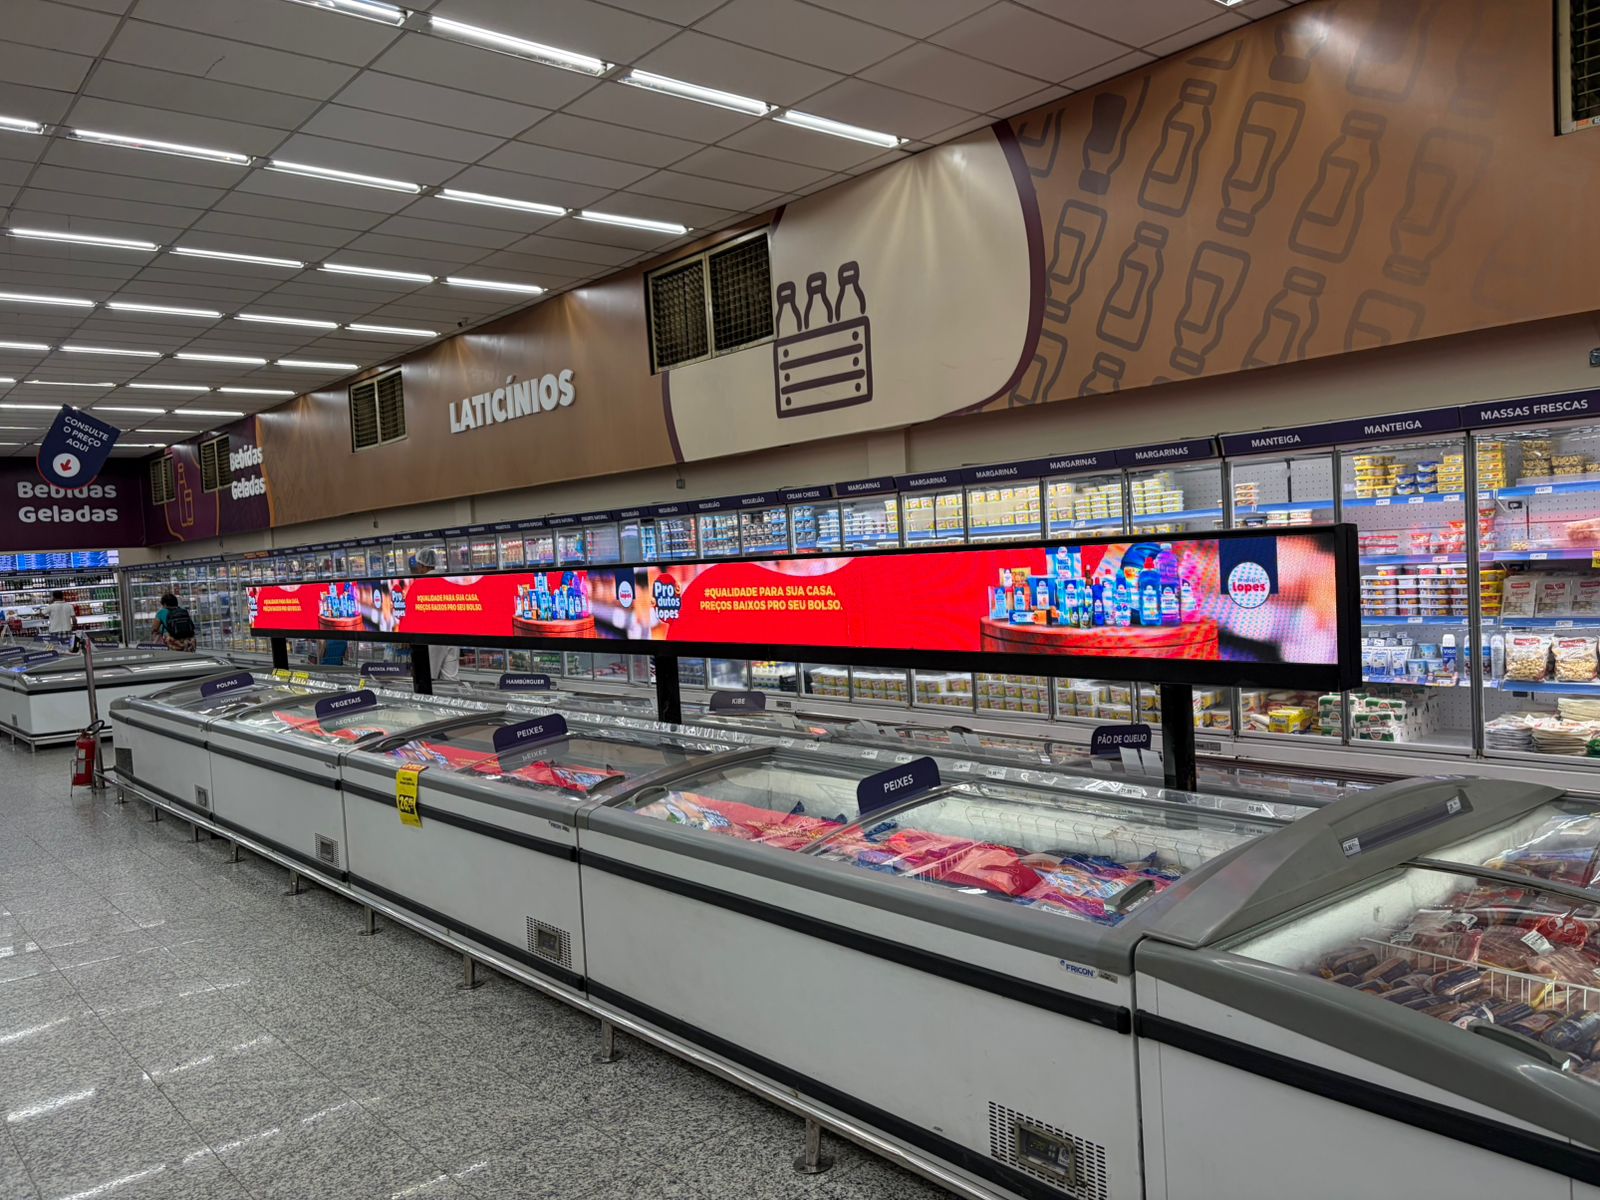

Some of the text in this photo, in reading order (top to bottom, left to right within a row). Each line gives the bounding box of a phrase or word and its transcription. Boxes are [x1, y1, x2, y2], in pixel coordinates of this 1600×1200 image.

[450, 368, 576, 434] LATICÍNIOS
[1481, 400, 1588, 420] MASSAS FRESCAS
[64, 416, 110, 441] CONSULTE
[1364, 420, 1422, 434] MANTEIGA
[66, 438, 89, 452] AQUI
[72, 430, 101, 448] PREÇO
[1251, 434, 1301, 448] MANTEIGA
[230, 445, 263, 472] Bebidas
[1135, 446, 1189, 460] MARGARINAS
[1050, 457, 1097, 470] MARGARINAS
[975, 466, 1018, 478] MARGARINAS
[232, 474, 266, 500] Geladas
[848, 481, 880, 491] MARGARINAS
[909, 476, 947, 487] MARGARINAS
[17, 481, 117, 498] Bebidas
[18, 505, 118, 524] Geladas
[654, 582, 674, 597] Pro
[704, 588, 758, 599] #QUALIDADE
[759, 586, 784, 597] PARA
[786, 586, 804, 596] SUA
[1232, 582, 1266, 594] lopes
[658, 596, 680, 607] dutos
[700, 600, 843, 613] PREÇOS BAIXOS PRO SEU BOLSO.
[656, 606, 679, 622] lopes
[216, 679, 238, 690] POLPAS
[506, 677, 544, 686] HAMBÚRGUER
[330, 696, 362, 710] VEGETAIS
[732, 698, 746, 706] KIBE
[516, 724, 544, 738] PEIXES
[1097, 732, 1148, 745] PÃO DE QUEIJO
[883, 774, 914, 794] PEIXES
[1066, 964, 1094, 977] FRICON
